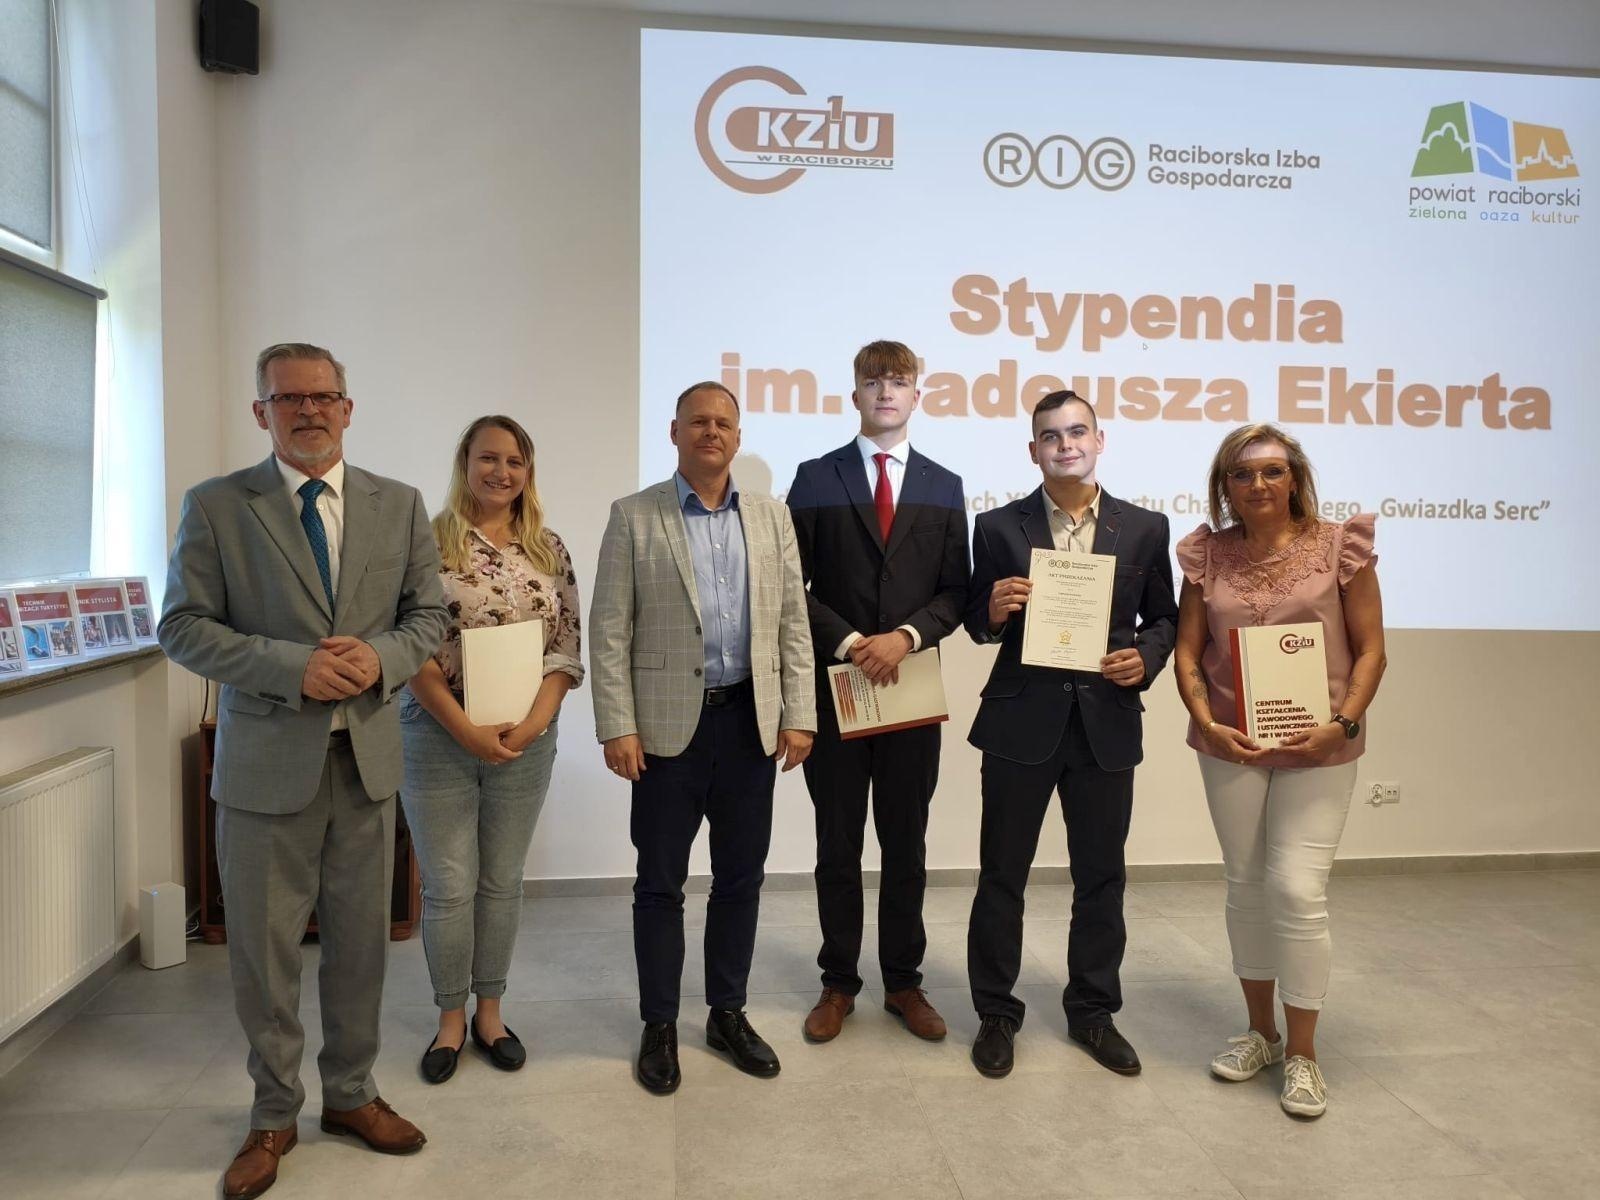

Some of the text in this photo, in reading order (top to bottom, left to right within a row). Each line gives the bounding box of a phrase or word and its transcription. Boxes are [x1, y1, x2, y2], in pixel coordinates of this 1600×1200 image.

[778, 155, 894, 168] RACIBORZU
[995, 141, 1128, 183] RIG
[1148, 144, 1321, 169] Raciborska Izba
[1147, 166, 1293, 190] Gospodarcza
[1409, 184, 1581, 206] powiat raciborski
[1409, 206, 1580, 224] zielona oaza kultur
[949, 274, 1344, 352] Stypendia
[720, 352, 1552, 431] im. adeusza Ekierta
[1256, 706, 1307, 715] KSZTAŁCENIA
[1257, 714, 1314, 723] ZAWODOWEGO
[1261, 722, 1319, 731] USTAWICZNEGO
